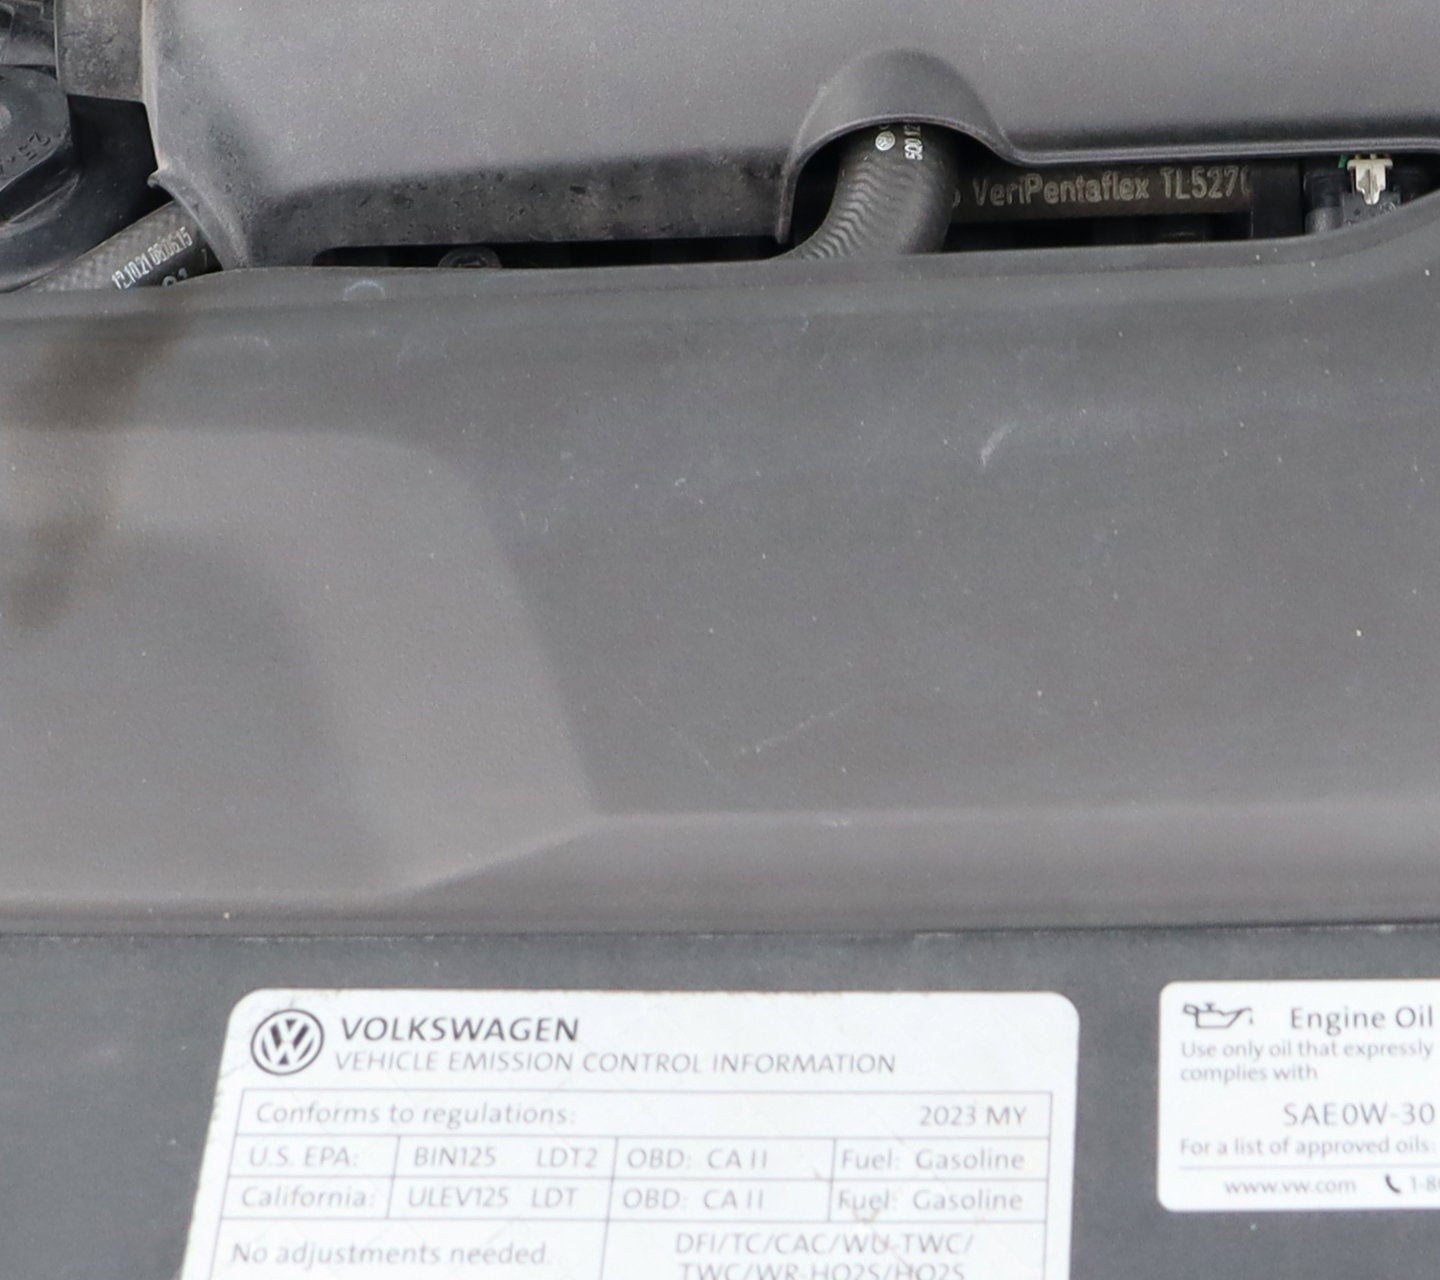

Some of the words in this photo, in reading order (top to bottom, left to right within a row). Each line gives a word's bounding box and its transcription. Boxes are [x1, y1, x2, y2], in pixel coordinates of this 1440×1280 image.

[972, 172, 1150, 207] VeriPentaflex
[340, 1015, 580, 1042] VOLKSWAGEN
[1290, 1006, 1385, 1036] Engine
[1396, 1005, 1434, 1029] Oil
[335, 1050, 437, 1071] VEHICLE
[448, 1051, 572, 1072] EMISSION
[583, 1052, 703, 1074] CONTROL
[712, 1053, 896, 1075] INFORMATION
[1180, 1041, 1215, 1059] Use
[1223, 1041, 1263, 1062] only
[1269, 1041, 1291, 1058] oil
[1297, 1040, 1337, 1058] that
[1343, 1040, 1433, 1062] expressly
[1180, 1064, 1267, 1085] complies
[1273, 1064, 1318, 1081] with
[256, 1101, 379, 1124] Conforms
[390, 1103, 414, 1124] to
[423, 1101, 576, 1128] regulations:
[919, 1105, 976, 1127] 2023
[985, 1106, 1027, 1126] MY
[248, 1147, 294, 1168] U.S.
[304, 1147, 358, 1167] EPA:
[414, 1147, 496, 1167] BIN125
[536, 1147, 598, 1168] LDT2
[627, 1147, 692, 1169] OBD:
[707, 1148, 741, 1169] CA
[842, 1148, 900, 1170] Fuel:
[916, 1147, 1024, 1170] Gasoline
[1179, 1138, 1210, 1156] For
[1218, 1141, 1228, 1155] a
[1234, 1138, 1264, 1156] list
[1269, 1137, 1289, 1155] of
[1295, 1136, 1389, 1160] approved
[1396, 1135, 1436, 1154] oils:
[241, 1186, 376, 1208] California:
[409, 1187, 508, 1207] ULEV125
[531, 1188, 578, 1208] LDT
[622, 1188, 687, 1209] OBD:
[703, 1189, 737, 1209] CA
[838, 1190, 897, 1211] Fuel:
[913, 1190, 1023, 1210] Gasoline
[1224, 1178, 1356, 1195] www.vw.com
[230, 1242, 268, 1264] No
[275, 1242, 440, 1270] adjustments
[450, 1242, 549, 1265] needed.
[674, 1232, 974, 1256] DFI/TC/CAC/WU-TWC/
